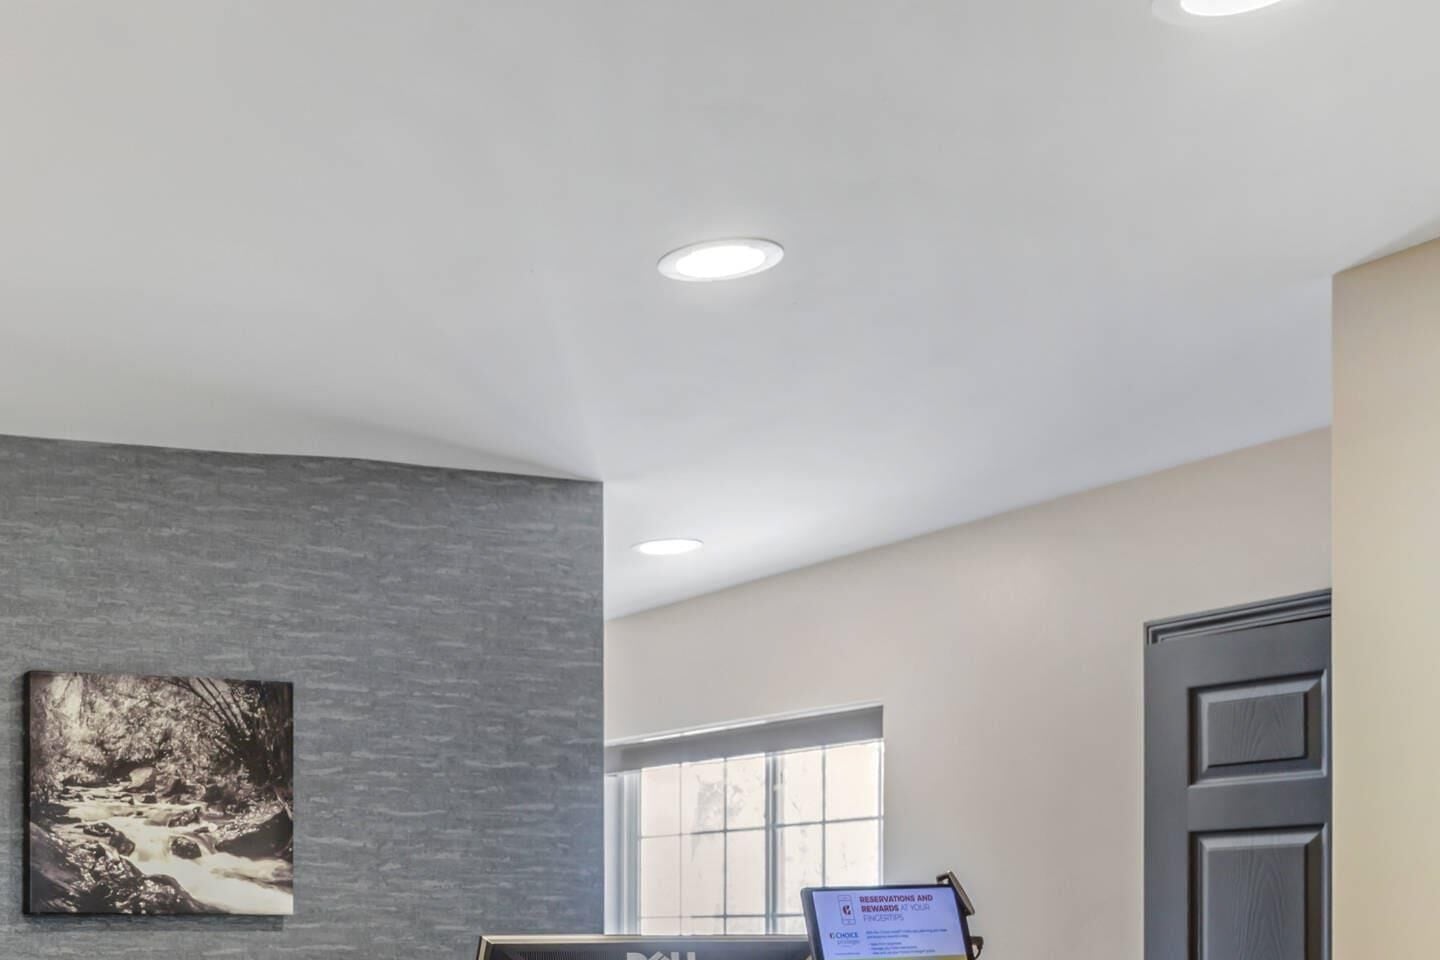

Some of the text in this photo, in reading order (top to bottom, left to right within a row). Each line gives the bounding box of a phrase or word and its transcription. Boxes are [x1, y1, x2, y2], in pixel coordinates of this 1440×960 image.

[859, 894, 933, 903] RESERVATIONS AND
[861, 904, 899, 912] REWARDS
[910, 903, 930, 911] YOUR
[863, 914, 904, 922] FINGERTIPS
